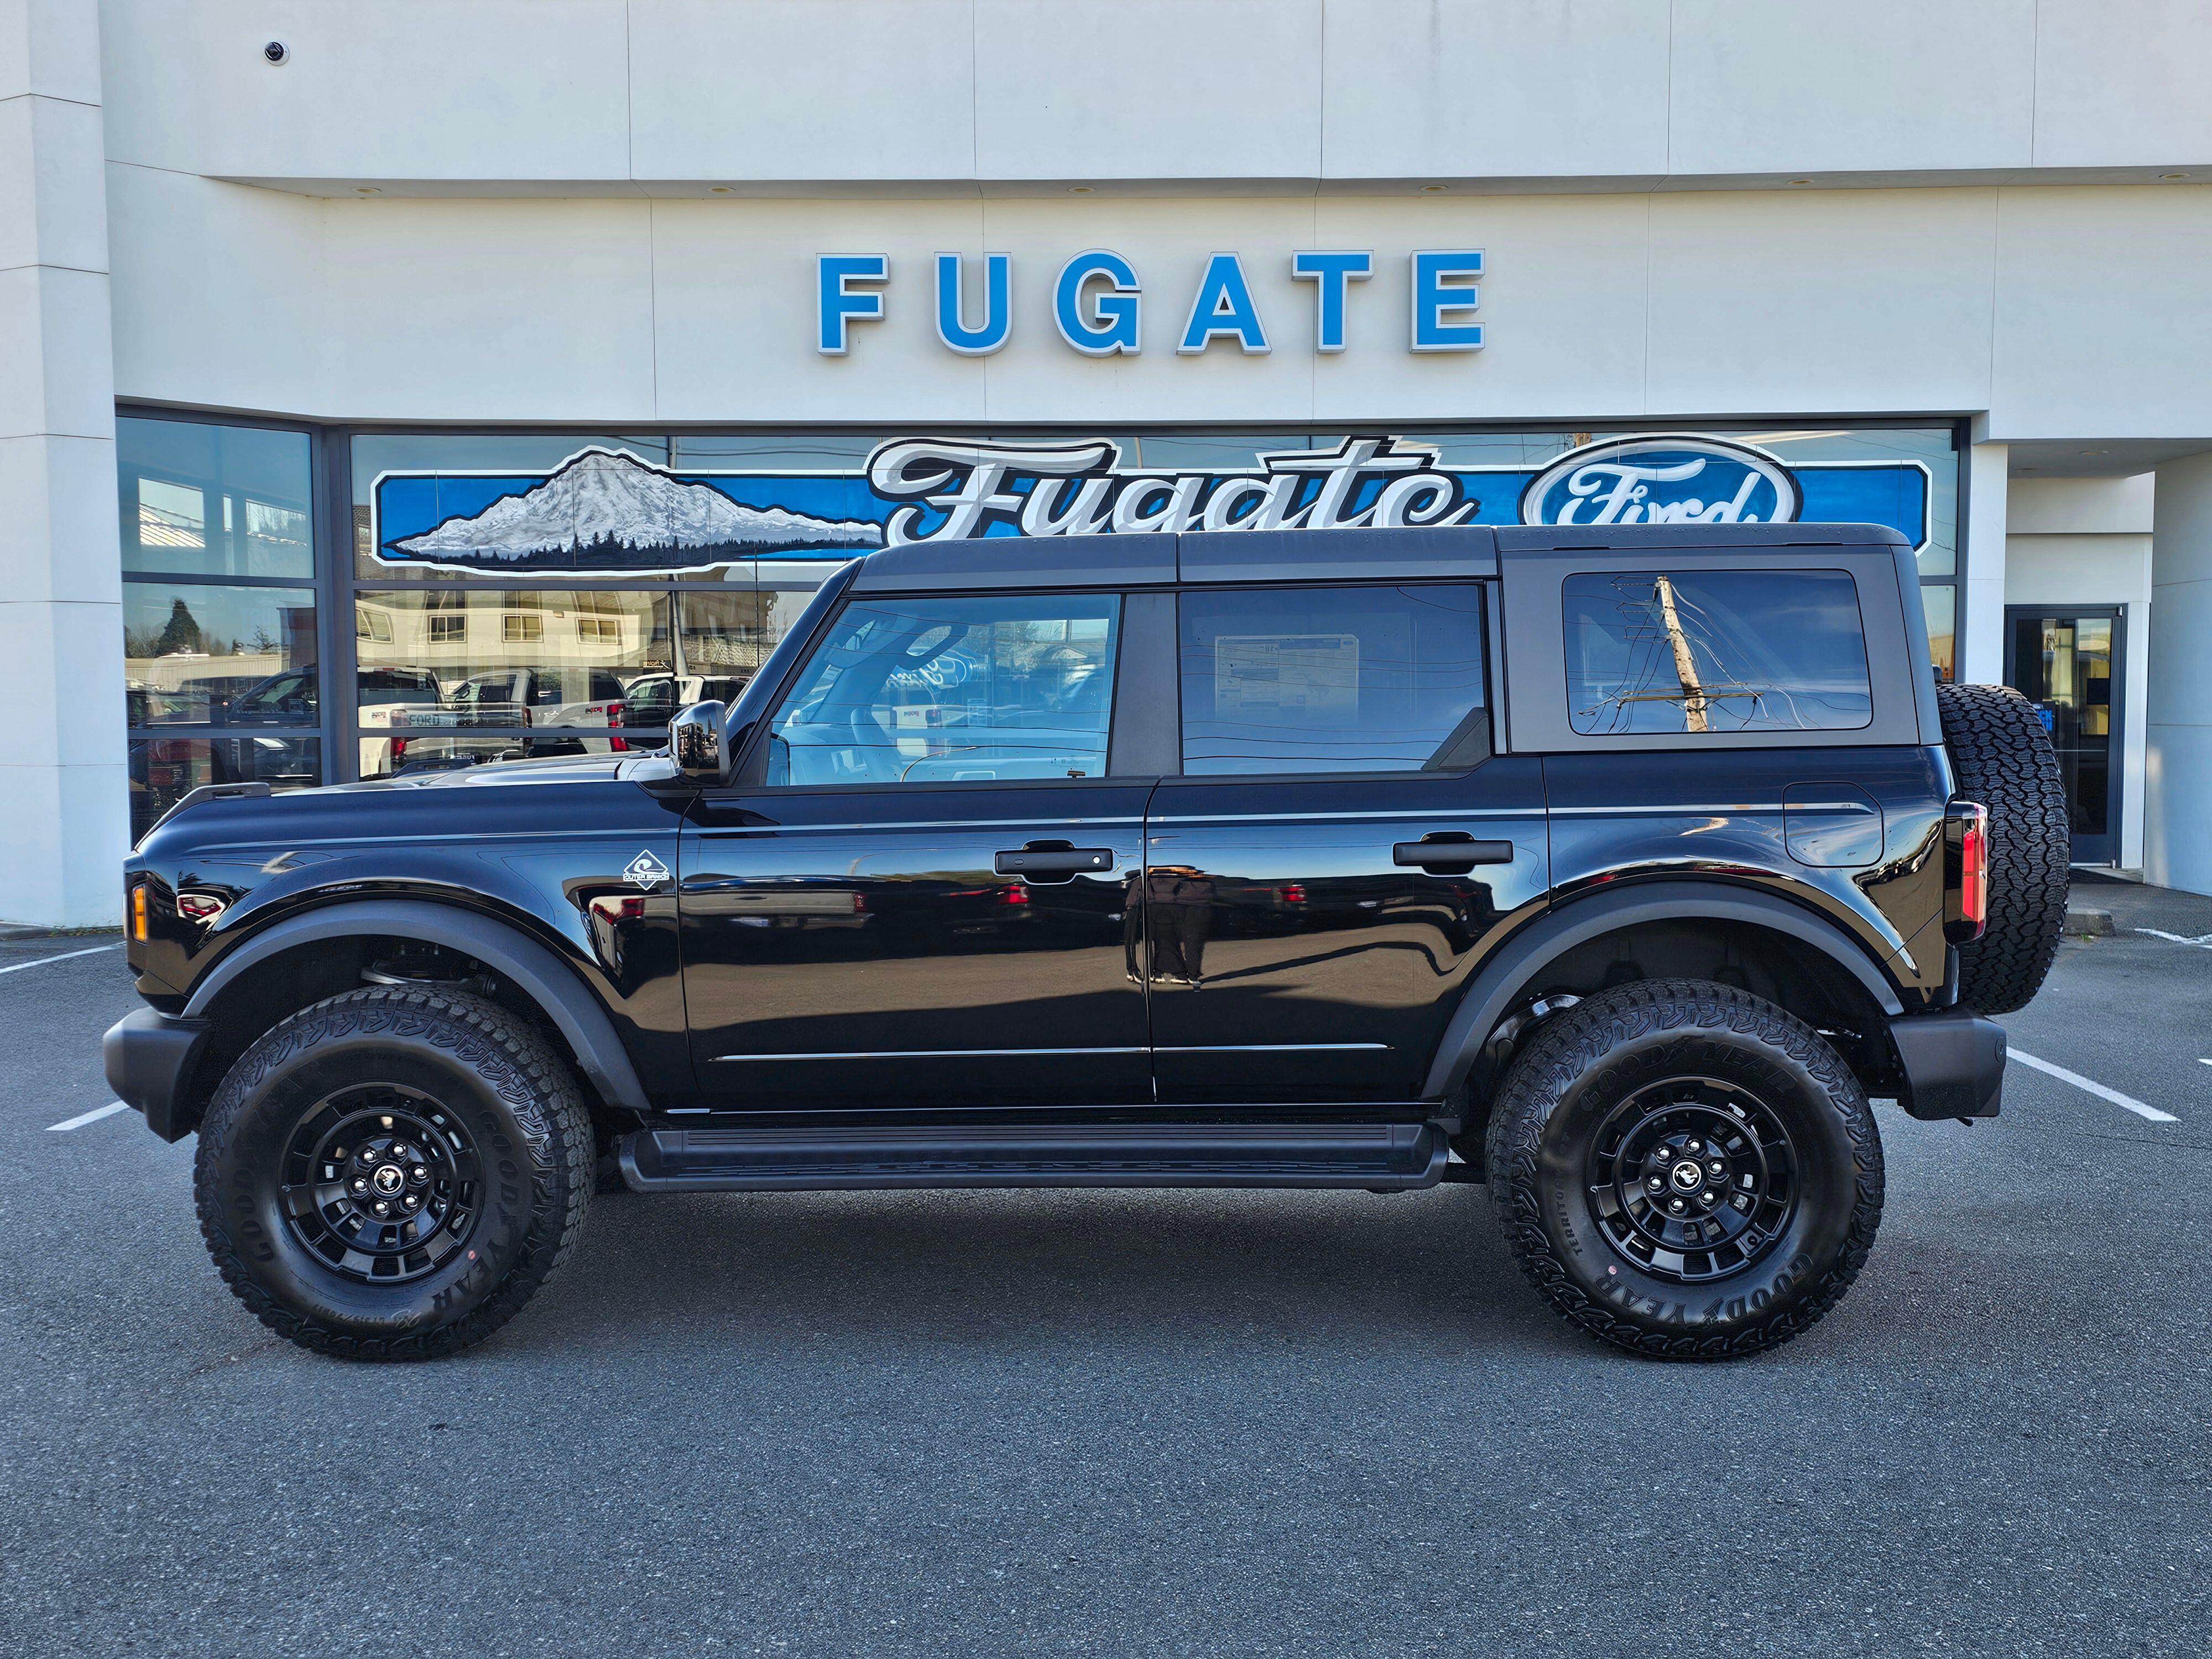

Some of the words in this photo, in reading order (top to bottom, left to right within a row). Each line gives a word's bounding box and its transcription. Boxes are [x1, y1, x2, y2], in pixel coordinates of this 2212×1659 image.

[816, 249, 1485, 356] FUGATE
[866, 436, 1480, 545] Fugate
[1557, 458, 1761, 525] Ford
